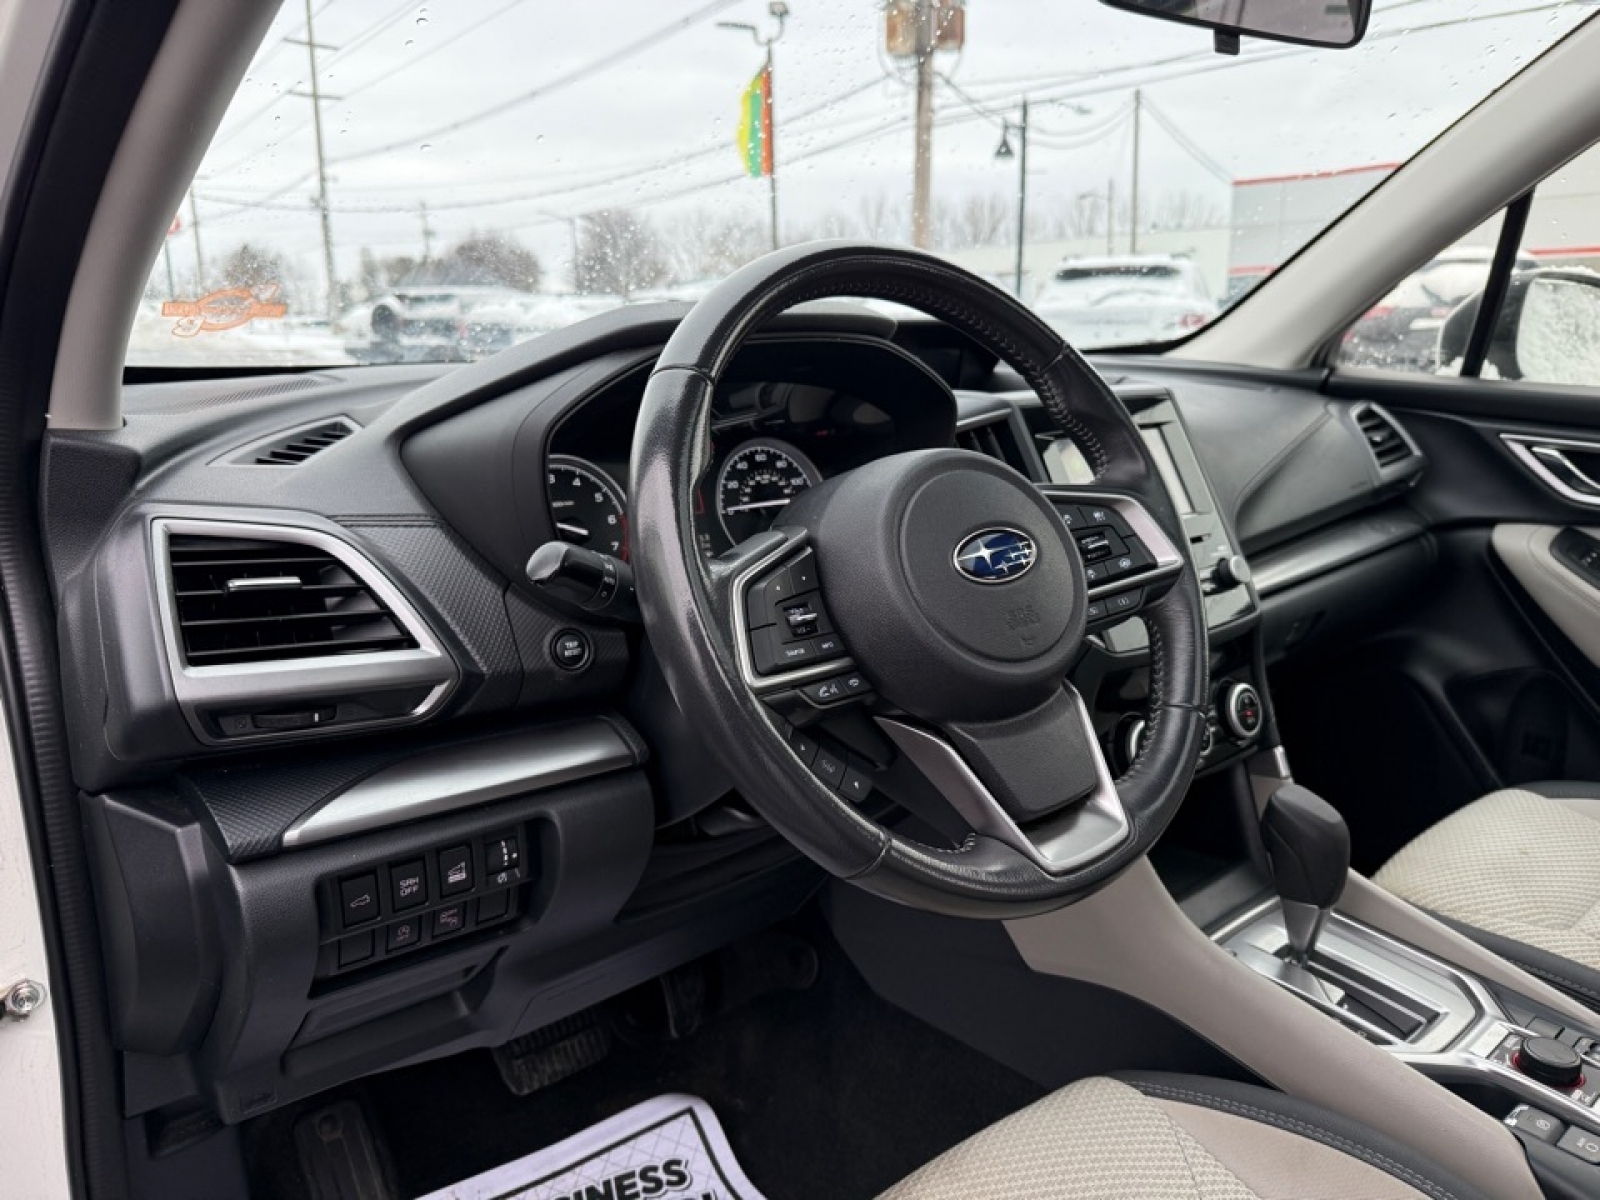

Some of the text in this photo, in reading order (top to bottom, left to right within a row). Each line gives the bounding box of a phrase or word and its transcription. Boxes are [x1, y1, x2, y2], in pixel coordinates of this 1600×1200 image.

[572, 477, 581, 487] 4
[594, 492, 604, 502] 5
[607, 514, 617, 525] 6
[610, 541, 620, 551] 7
[400, 884, 419, 898] OFF
